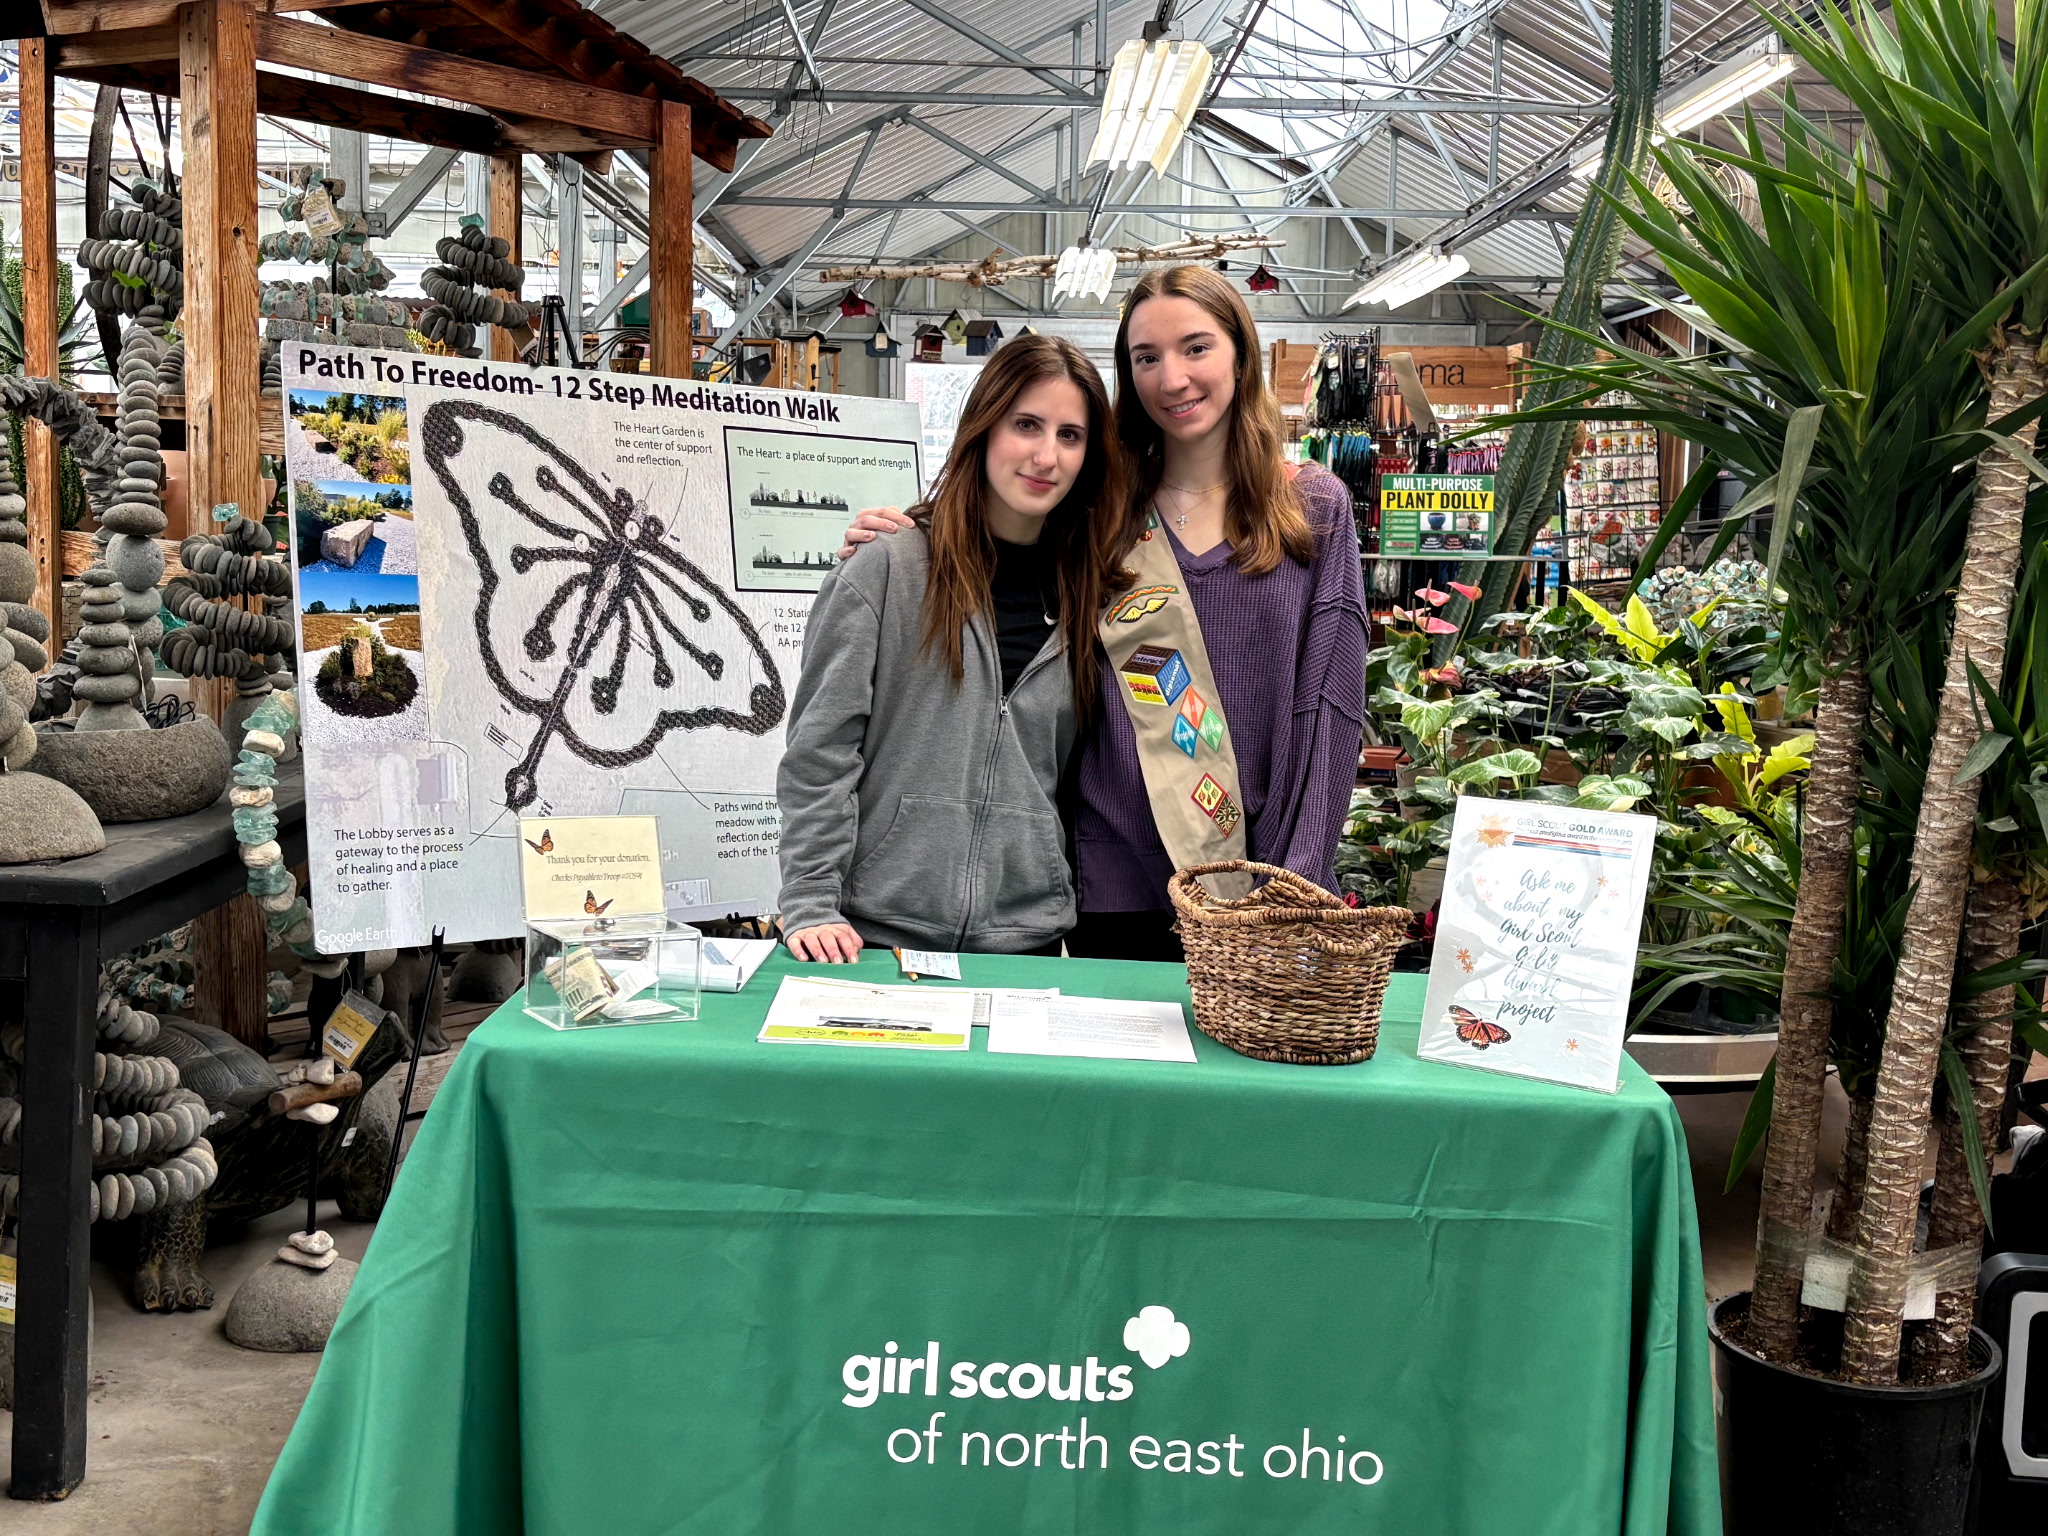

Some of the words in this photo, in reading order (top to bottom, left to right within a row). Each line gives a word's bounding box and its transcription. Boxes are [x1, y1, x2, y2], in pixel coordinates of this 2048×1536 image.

[1416, 364, 1466, 386] ma
[299, 350, 364, 380] Path
[371, 357, 404, 383] To
[412, 361, 543, 395] Freedom-
[552, 375, 580, 399] 12
[589, 378, 645, 410] Step
[653, 384, 781, 417] Meditation
[785, 397, 840, 422] Walk
[614, 421, 632, 433] The
[634, 423, 660, 435] Heart
[662, 424, 696, 437] Garden
[698, 428, 705, 438] is
[615, 437, 631, 448] the
[633, 439, 662, 450] center
[664, 440, 675, 451] of
[677, 443, 713, 455] support
[616, 453, 634, 464] and
[636, 453, 684, 467] reflection.
[737, 446, 754, 457] The
[756, 448, 782, 459] Heart:
[785, 452, 791, 460] a
[792, 451, 815, 463] place
[817, 452, 826, 462] of
[827, 454, 859, 466] support
[861, 456, 876, 466] and
[878, 458, 912, 470] strength
[1393, 477, 1483, 491] MULTI-PURPOSE
[1386, 492, 1435, 509] PLANT
[1440, 493, 1488, 509] DOLLY
[774, 608, 784, 618] 12
[774, 623, 788, 633] the
[791, 623, 801, 633] 12
[778, 637, 790, 647] AA
[714, 802, 739, 813] Paths
[741, 800, 763, 811] wind
[715, 817, 755, 828] meadow
[757, 815, 776, 826] with
[1517, 818, 1535, 827] GIRL
[1538, 820, 1567, 830] SCOUT
[1569, 824, 1596, 833] GOLD
[1598, 827, 1633, 838] AWARD
[334, 829, 356, 841] The
[358, 828, 394, 841] Lobby
[396, 827, 432, 838] serves
[434, 827, 446, 836] as
[448, 827, 455, 836] a
[716, 832, 759, 843] reflection
[335, 847, 384, 861] gateway
[386, 845, 399, 856] to
[401, 843, 420, 855] the
[422, 843, 464, 856] process
[546, 855, 571, 864] Thank
[571, 857, 585, 866] you
[586, 854, 598, 863] for
[599, 856, 616, 865] your
[718, 848, 739, 859] each
[741, 847, 750, 857] of
[752, 846, 768, 857] the
[336, 864, 349, 876] of
[351, 863, 393, 876] healing
[396, 860, 417, 872] and
[420, 862, 427, 871] a
[429, 859, 459, 872] place
[338, 882, 350, 893] to
[352, 880, 393, 895] gather.
[1520, 869, 1551, 891] Ask
[1554, 881, 1575, 893] me
[1504, 890, 1551, 918] about
[1559, 907, 1584, 929] my
[316, 927, 364, 947] Google
[365, 926, 398, 941] Earth
[1497, 918, 1534, 943] Girl
[1536, 922, 1583, 948] Scout
[1496, 1000, 1558, 1025] project
[842, 1341, 940, 1408] girl
[949, 1357, 1134, 1402] scouts
[887, 1412, 946, 1466] of
[961, 1417, 1109, 1470] north
[1129, 1433, 1245, 1479] east
[1262, 1428, 1385, 1486] ohio
